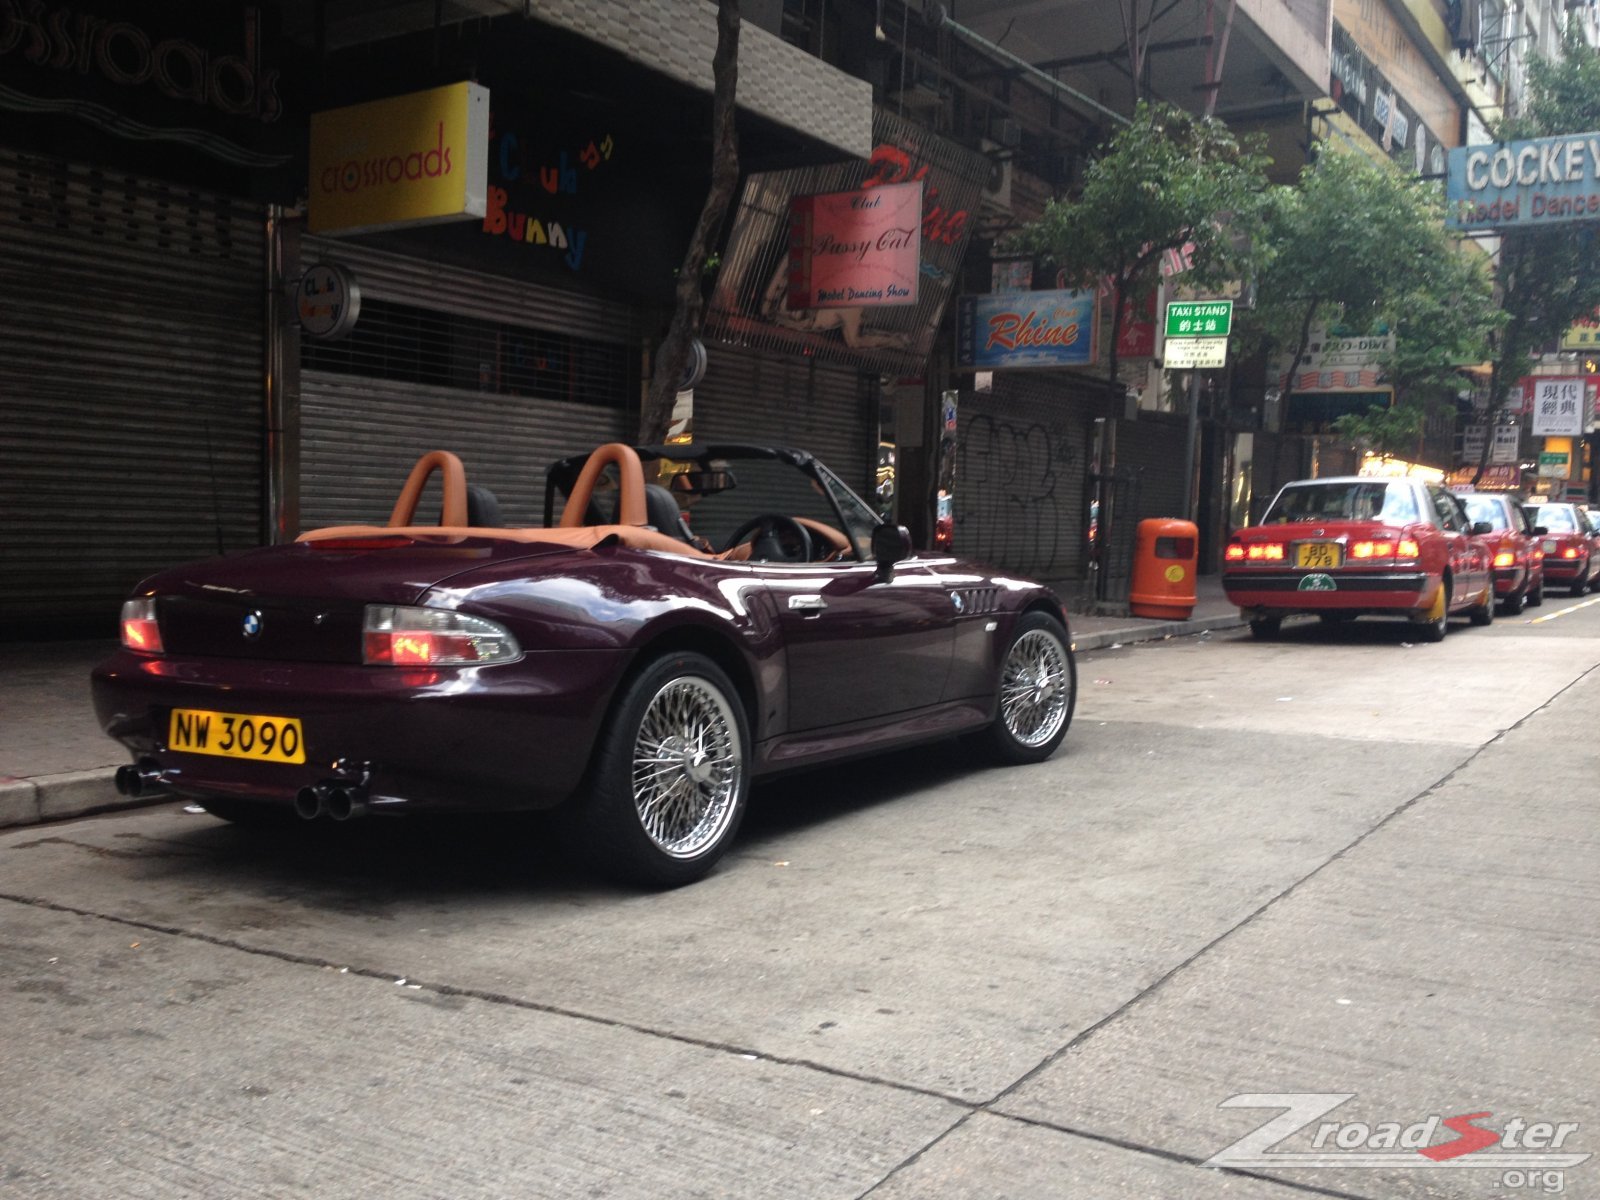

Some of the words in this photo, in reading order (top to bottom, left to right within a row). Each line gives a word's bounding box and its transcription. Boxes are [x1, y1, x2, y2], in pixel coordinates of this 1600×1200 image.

[320, 121, 452, 193] crossroads
[483, 184, 588, 271] Bunny
[875, 228, 917, 252] Cat
[848, 287, 882, 301] Dancing
[887, 284, 910, 298] Show
[1171, 306, 1192, 317] TAXI
[1194, 305, 1228, 316] STAND
[985, 310, 1080, 351] Rhine
[1179, 319, 1217, 331] 的士站
[1542, 384, 1578, 400] 現代
[1541, 400, 1577, 415] 經典
[176, 713, 210, 748] NW
[219, 717, 298, 757] 3090
